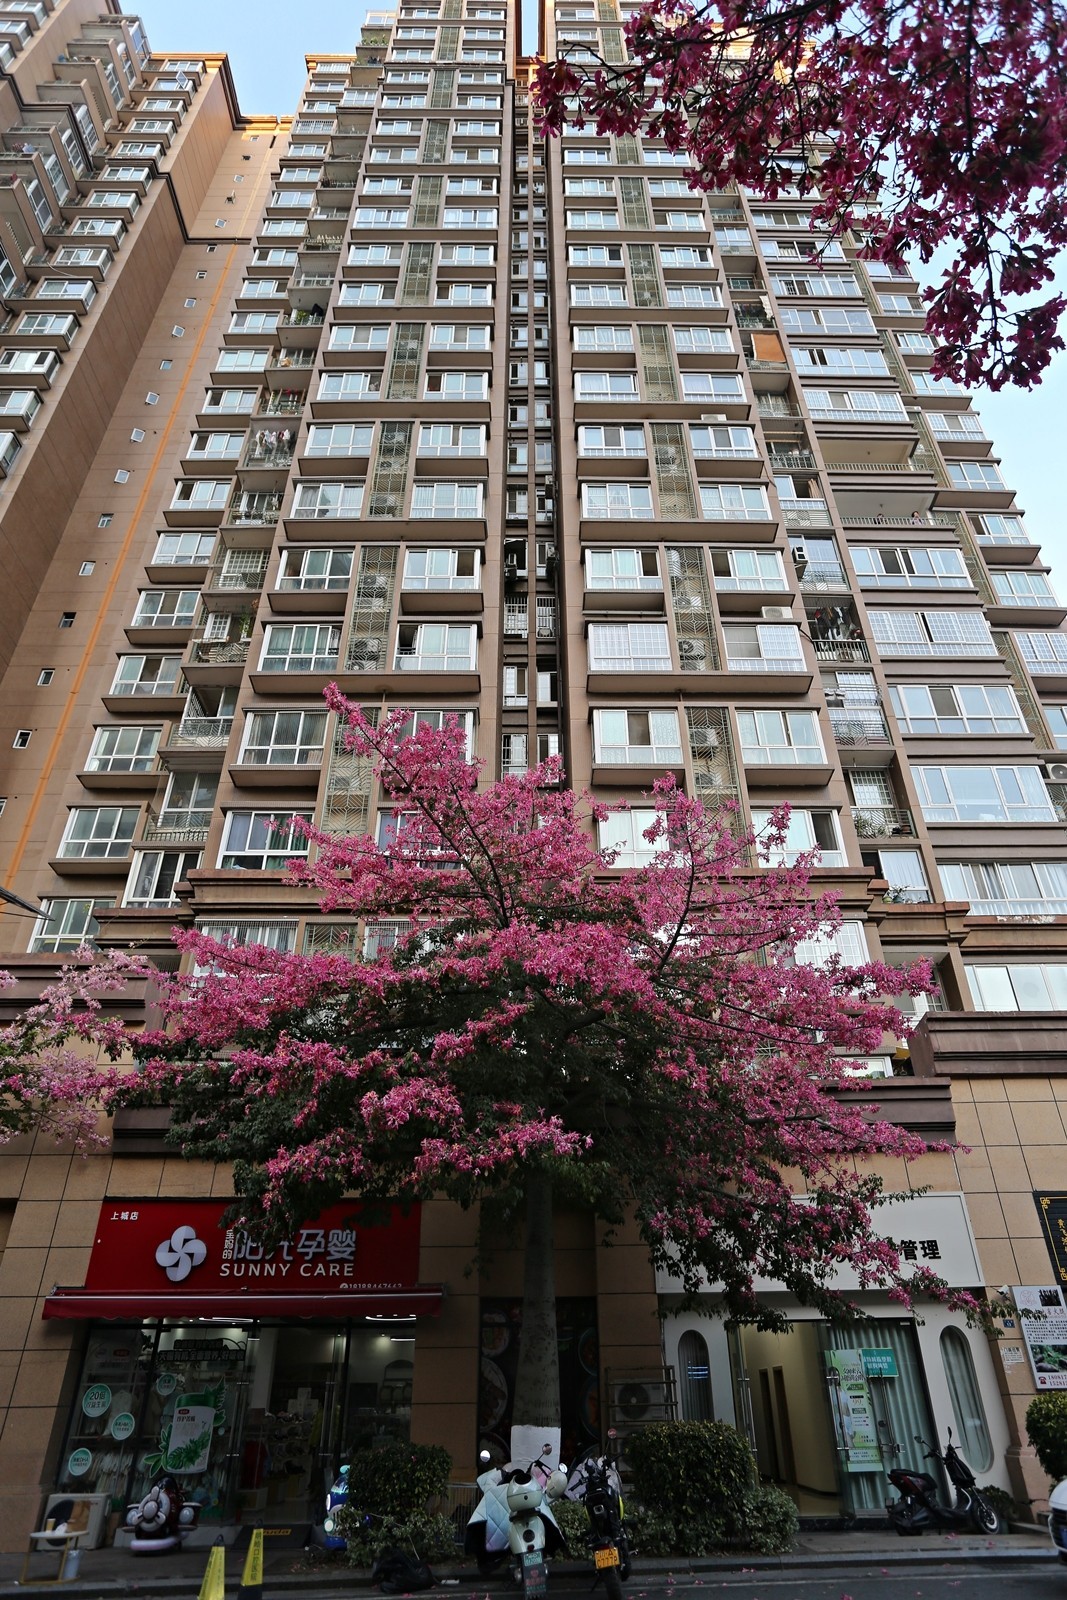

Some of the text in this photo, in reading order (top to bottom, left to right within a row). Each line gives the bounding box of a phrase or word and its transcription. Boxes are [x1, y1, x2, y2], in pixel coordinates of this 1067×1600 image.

[110, 1211, 139, 1221] 上城店
[219, 1263, 355, 1277] SUNNY CARE
